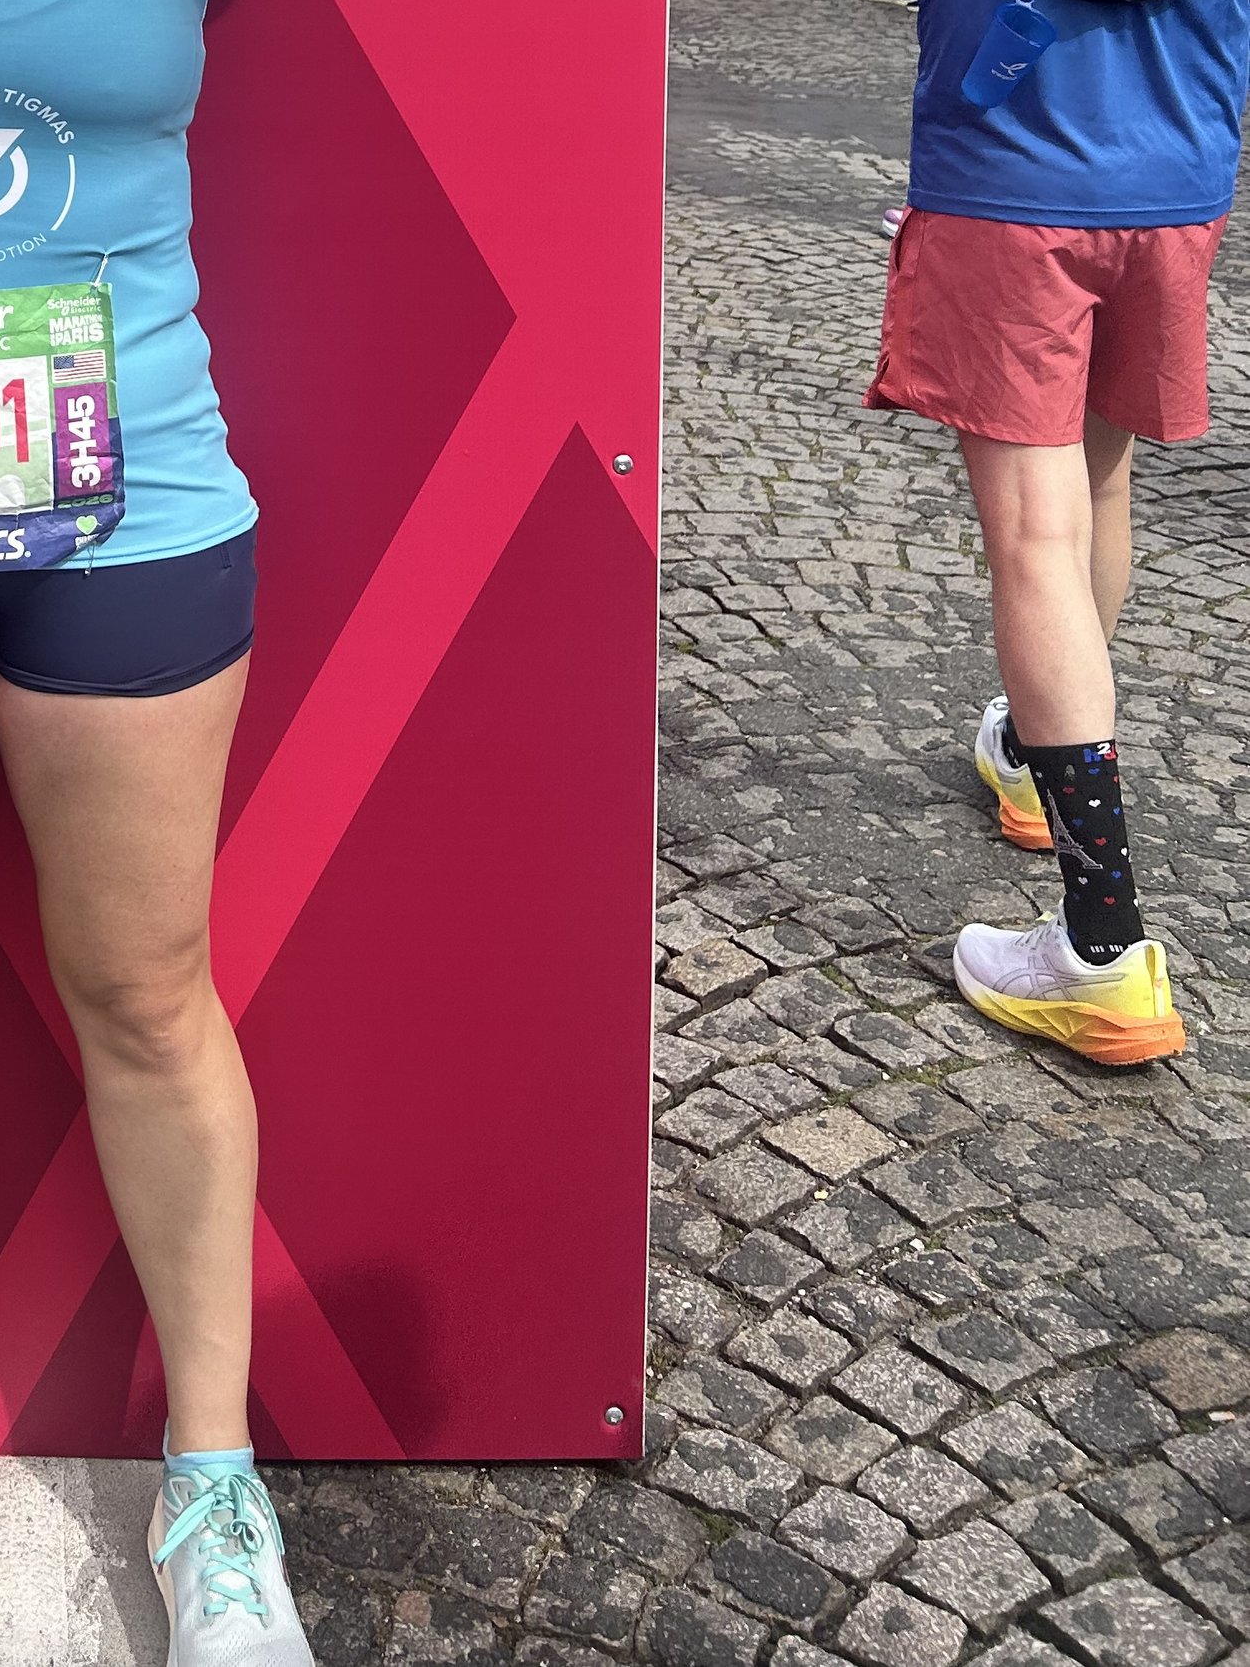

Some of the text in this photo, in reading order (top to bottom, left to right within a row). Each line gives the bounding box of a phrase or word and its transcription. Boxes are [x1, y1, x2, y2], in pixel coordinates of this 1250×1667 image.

[46, 296, 102, 310] Schneider
[55, 322, 105, 346] PARIS
[67, 394, 101, 489] 3H45
